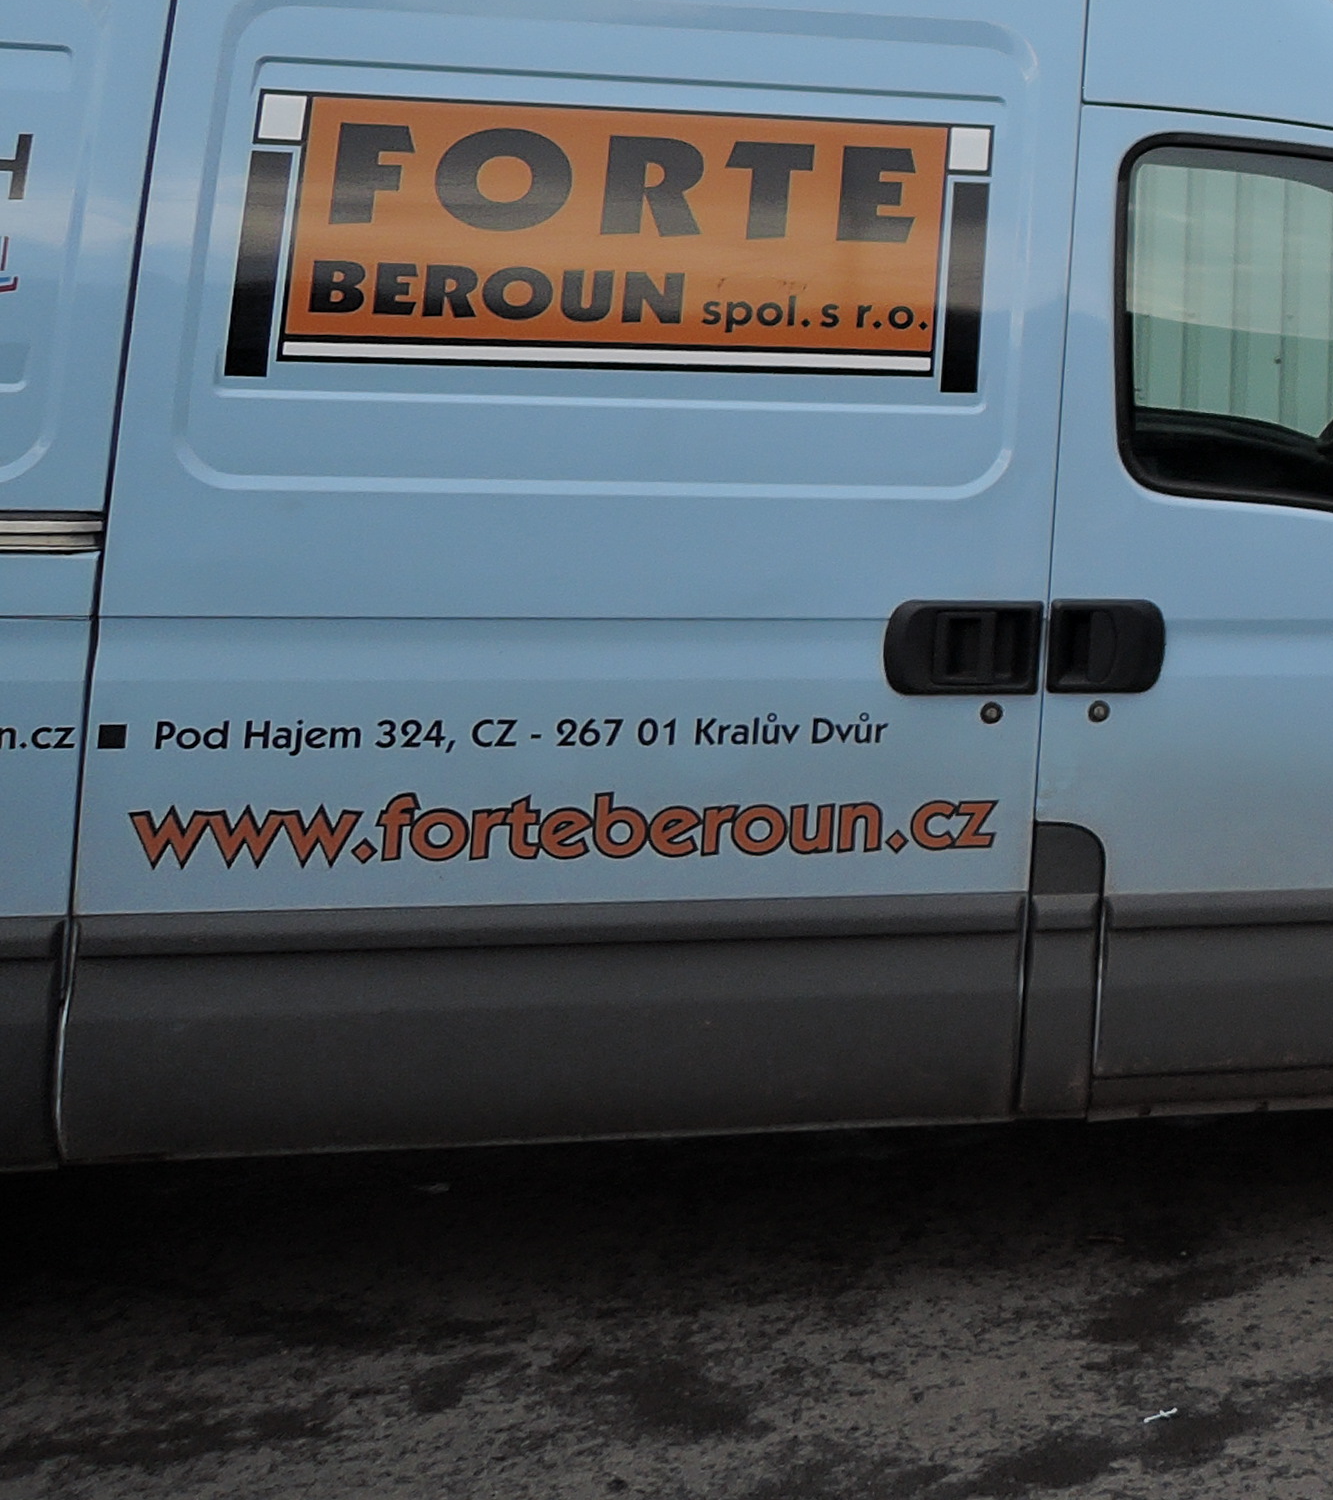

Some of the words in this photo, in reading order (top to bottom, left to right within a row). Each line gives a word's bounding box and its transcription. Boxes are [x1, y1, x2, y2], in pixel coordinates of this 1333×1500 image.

[328, 122, 917, 243] FORTE
[308, 260, 685, 324] BEROUN
[856, 304, 929, 331] r.o.
[155, 720, 231, 750] Pod
[244, 719, 362, 756] Hajem
[375, 719, 457, 753] 324,
[471, 718, 518, 747] CZ
[556, 718, 624, 746] 267
[637, 718, 678, 746] 01
[694, 712, 800, 746] Kralův
[811, 712, 889, 745] Dvůr
[128, 791, 998, 870] www.forteberoun.cz
